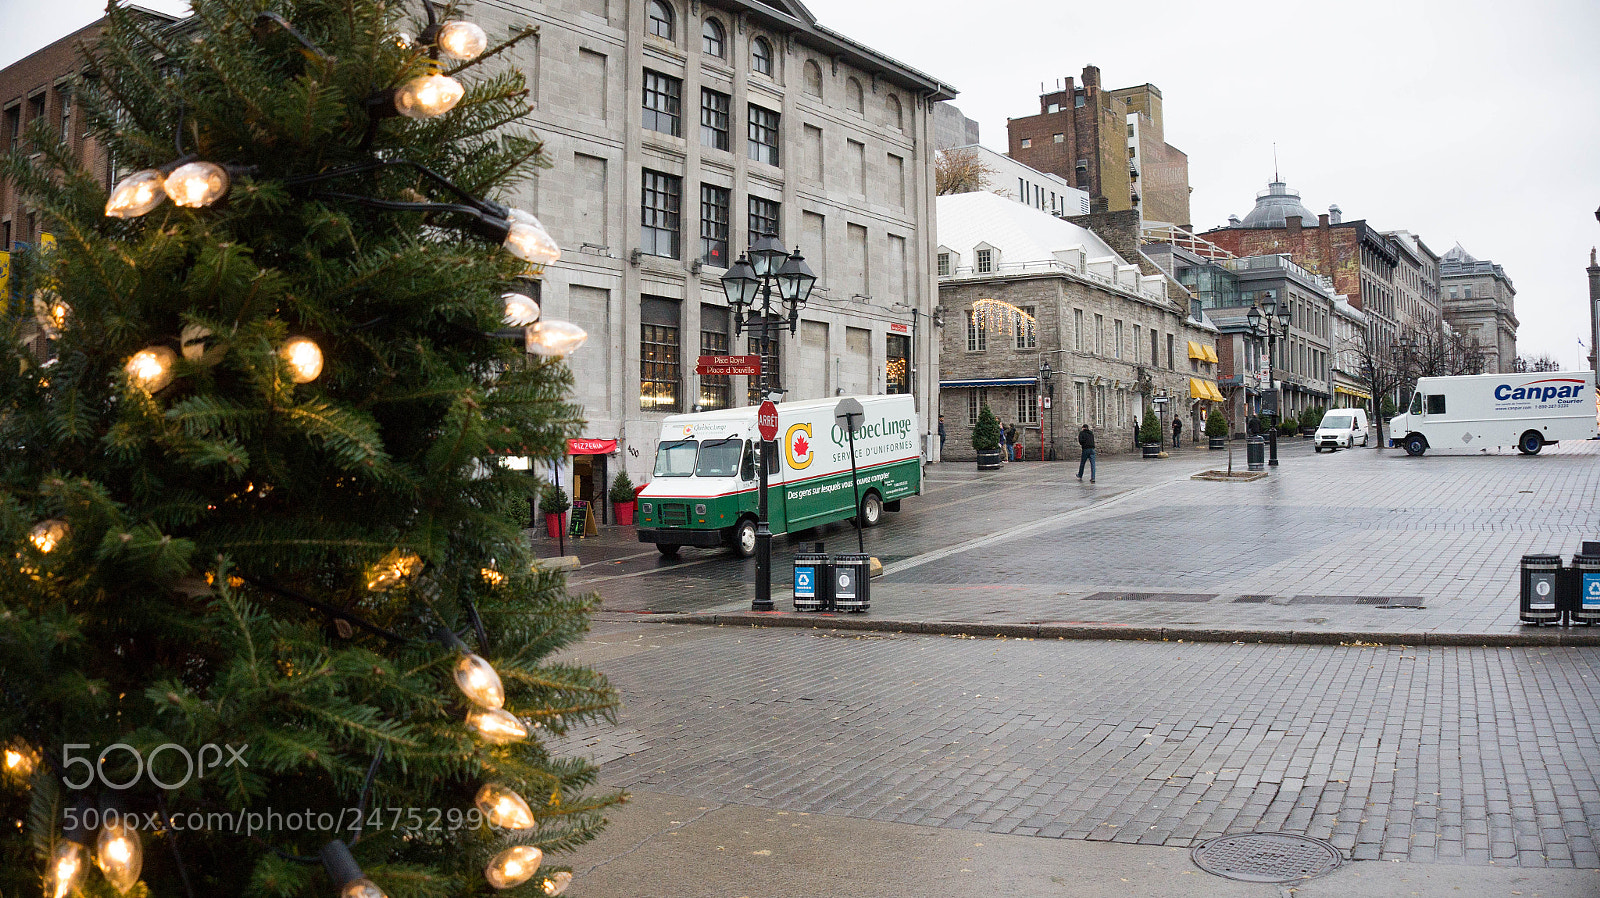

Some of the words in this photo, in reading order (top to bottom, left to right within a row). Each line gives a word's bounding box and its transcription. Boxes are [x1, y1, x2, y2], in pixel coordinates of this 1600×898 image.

[714, 356, 728, 364] Place
[706, 366, 724, 374] Place
[1494, 384, 1584, 402] Canpar
[758, 413, 778, 428] ARRÊT
[573, 442, 604, 450] PIZZERIA
[832, 448, 863, 463] SERVCE
[865, 440, 913, 457] D'UNIFORMES
[787, 490, 798, 500] Des
[798, 488, 812, 500] gens
[812, 486, 820, 495] sur
[820, 482, 841, 493] lesquels
[841, 480, 853, 489] vous
[856, 476, 871, 486] ouvez
